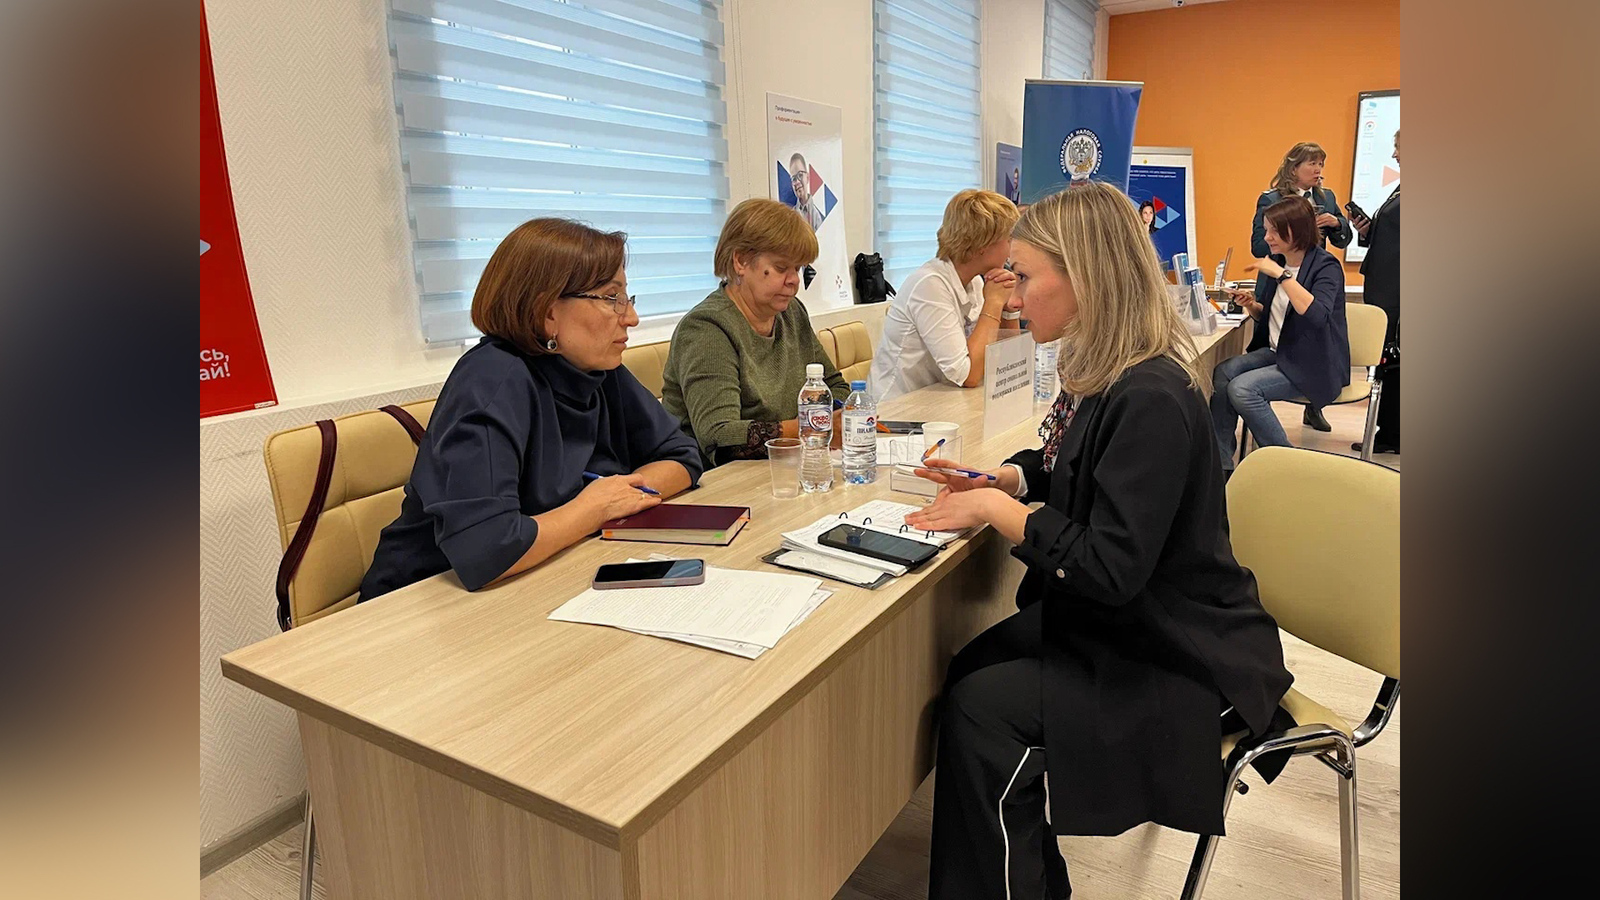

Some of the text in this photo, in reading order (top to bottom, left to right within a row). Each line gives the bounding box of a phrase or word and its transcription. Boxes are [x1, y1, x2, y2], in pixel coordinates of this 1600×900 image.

[1060, 129, 1103, 174] ФЕДЕРАЛЬНАЯ НАЛОГОВАЯ СЛУЖБА
